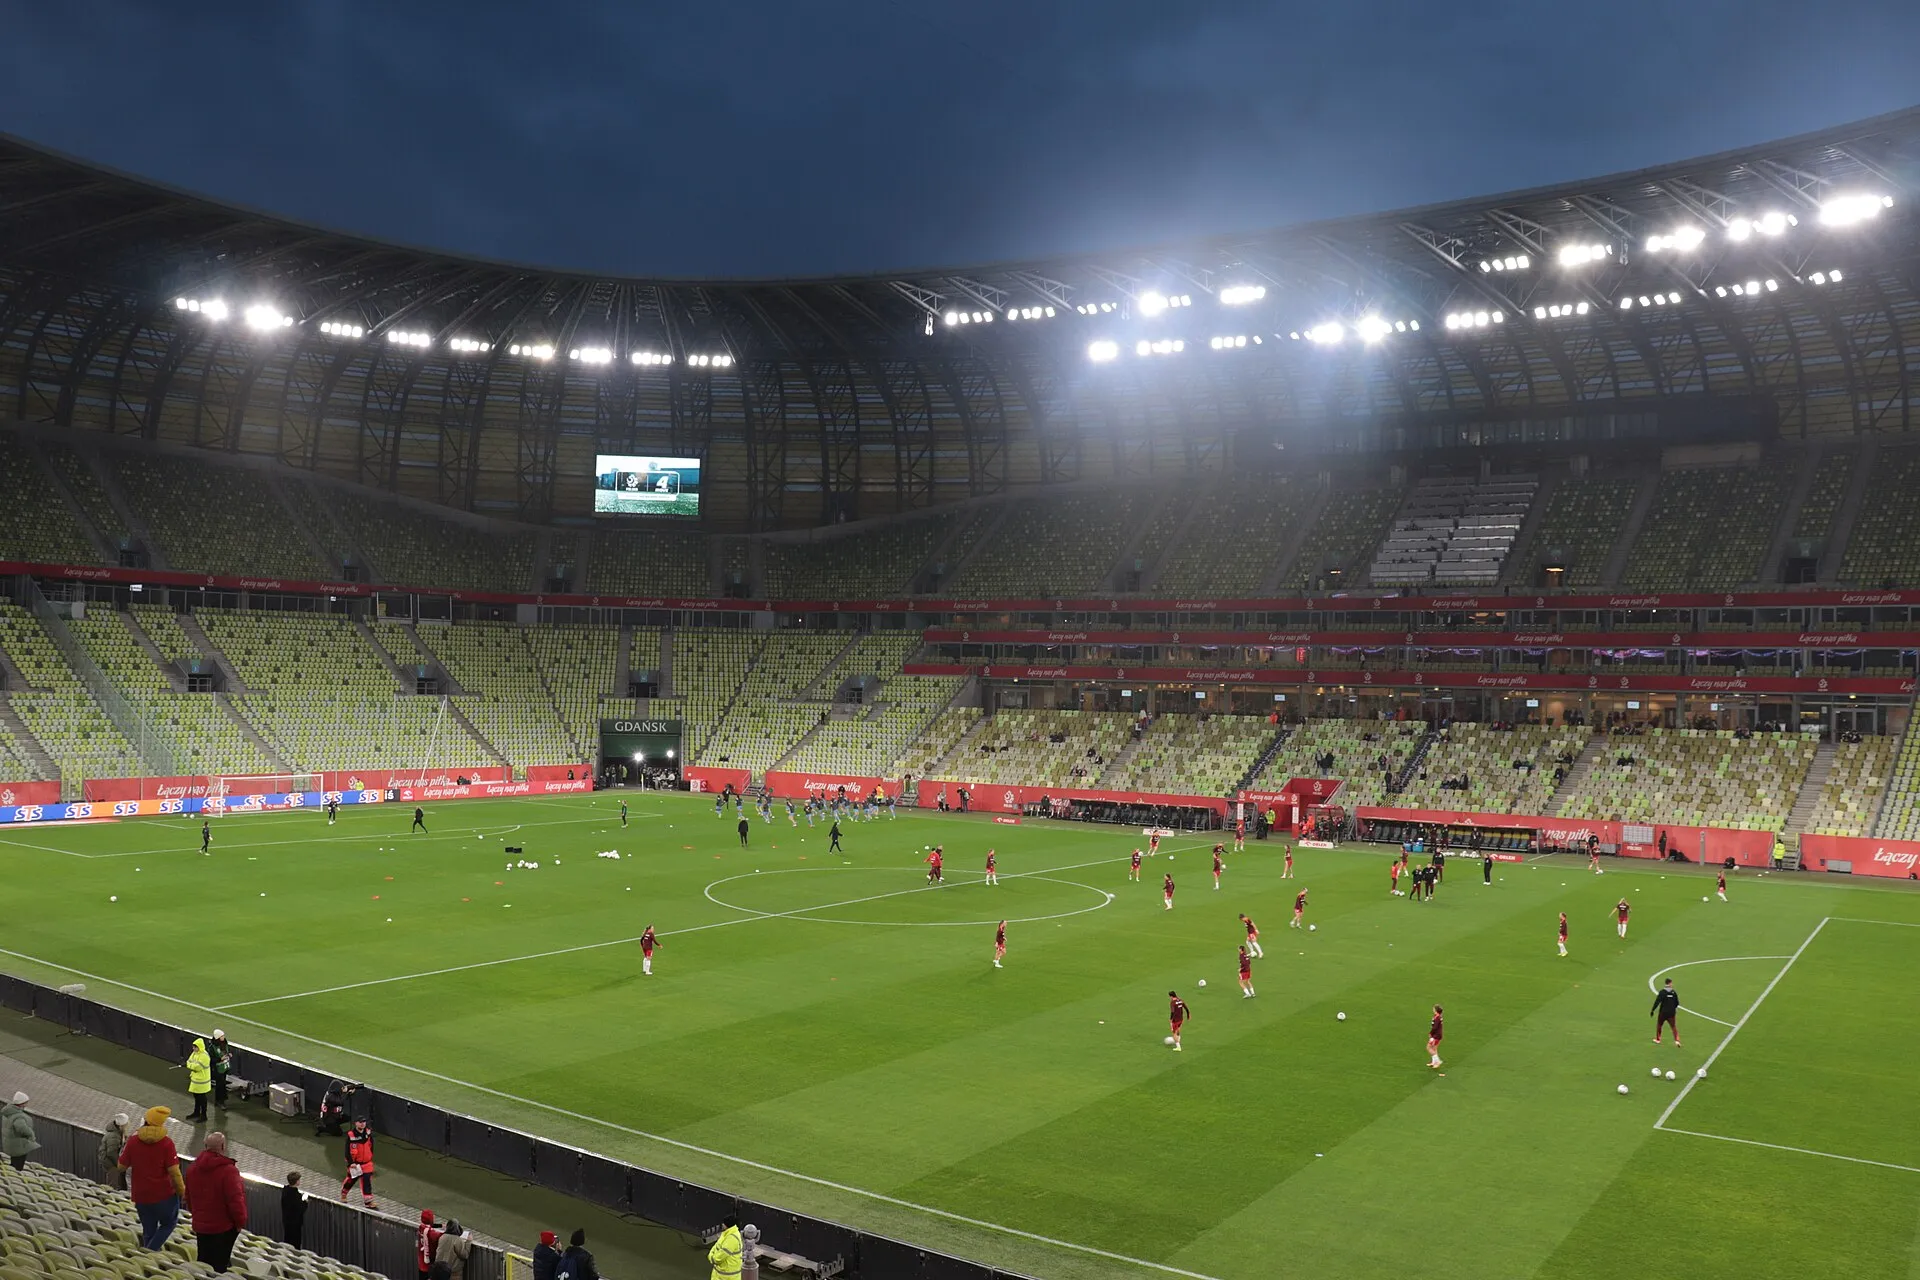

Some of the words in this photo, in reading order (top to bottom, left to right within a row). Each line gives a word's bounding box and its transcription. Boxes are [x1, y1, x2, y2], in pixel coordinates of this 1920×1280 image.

[615, 720, 666, 732] GDAŃSK
[413, 779, 429, 787] nas
[188, 786, 205, 796] nas
[323, 791, 344, 804] STS
[359, 790, 380, 803] STS
[160, 799, 183, 813] STS
[203, 797, 226, 809] STS
[245, 795, 266, 806] STS
[284, 793, 304, 807] STS
[16, 805, 43, 820] STS
[65, 803, 92, 818] STS
[113, 801, 139, 816] STS
[1546, 829, 1566, 840] nas
[1874, 848, 1919, 869] Łączy
